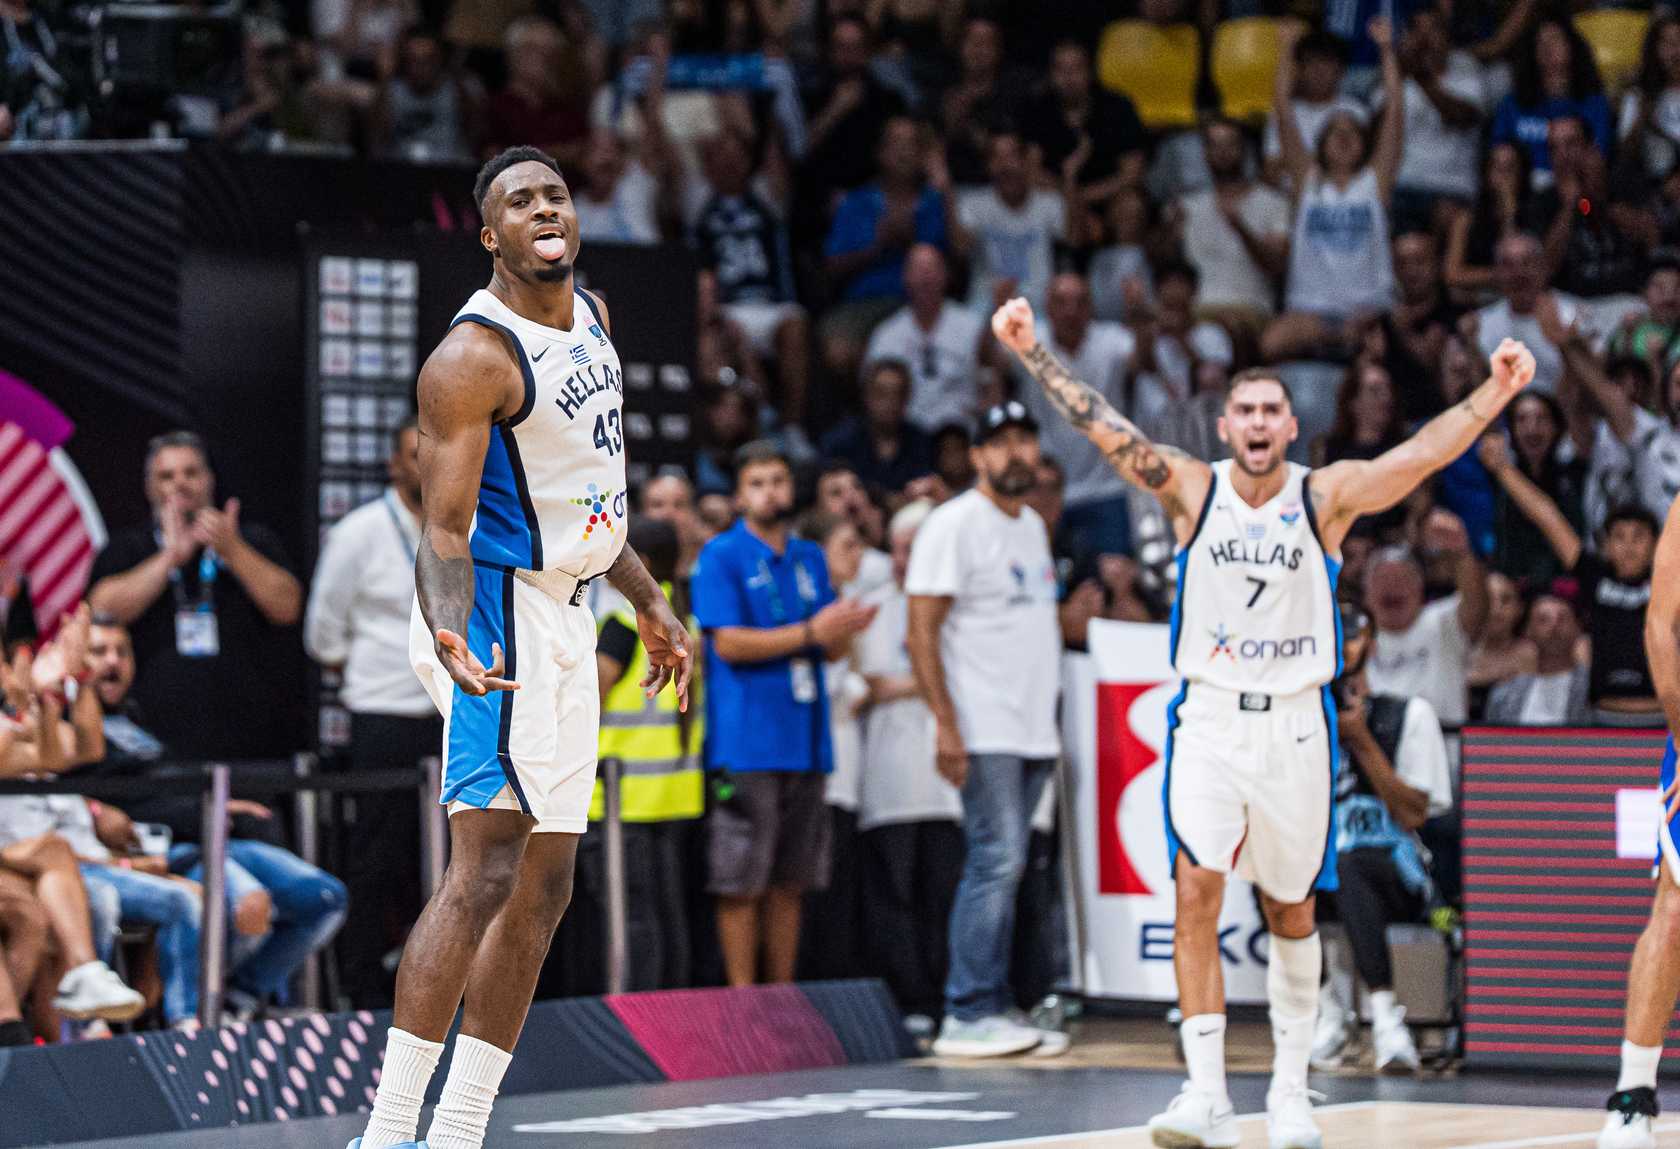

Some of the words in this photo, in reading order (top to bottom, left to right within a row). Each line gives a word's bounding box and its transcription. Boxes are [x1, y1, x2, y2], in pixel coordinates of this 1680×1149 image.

[593, 408, 622, 457] 43
[1209, 539, 1304, 572] HELLAS
[1245, 576, 1267, 609] 7
